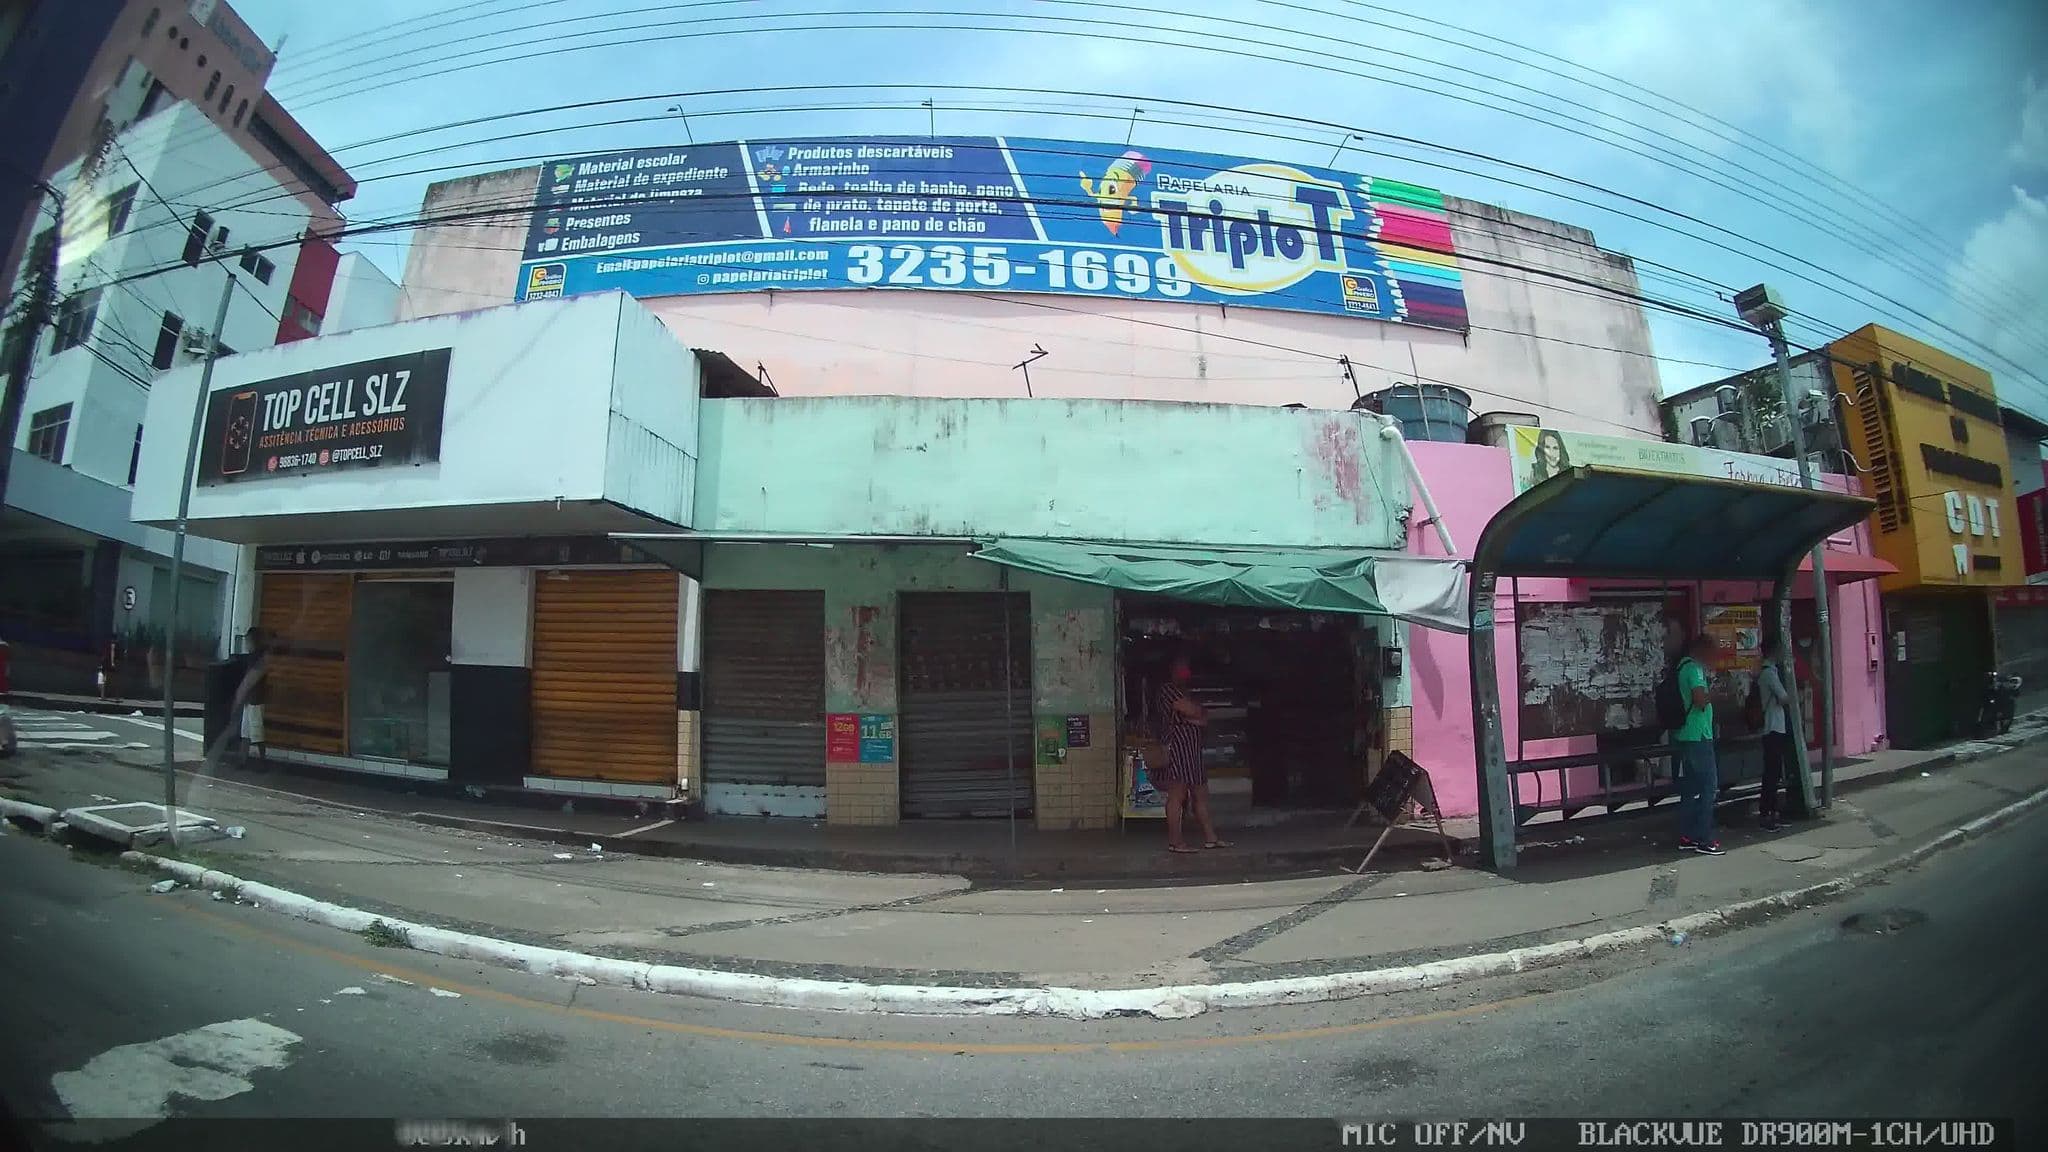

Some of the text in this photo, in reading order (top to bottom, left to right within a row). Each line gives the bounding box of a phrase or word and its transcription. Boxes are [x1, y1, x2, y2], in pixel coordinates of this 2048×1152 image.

[788, 145, 954, 160] Produtos descartáveis
[578, 152, 688, 176] Material escolar
[792, 162, 870, 177] Armarinho
[574, 166, 729, 194] Material de expediente
[898, 181, 914, 194] de
[803, 198, 822, 212] de
[932, 199, 951, 213] de
[565, 213, 632, 231] Presentes
[809, 216, 986, 234] flanela e pano de chão
[561, 231, 641, 252] Embalagens
[847, 243, 1193, 297] 3235-1699
[263, 370, 411, 431] TOP CELL SLZ
[341, 423, 347, 437] E
[332, 445, 383, 464] @TOPCELL_SLZ
